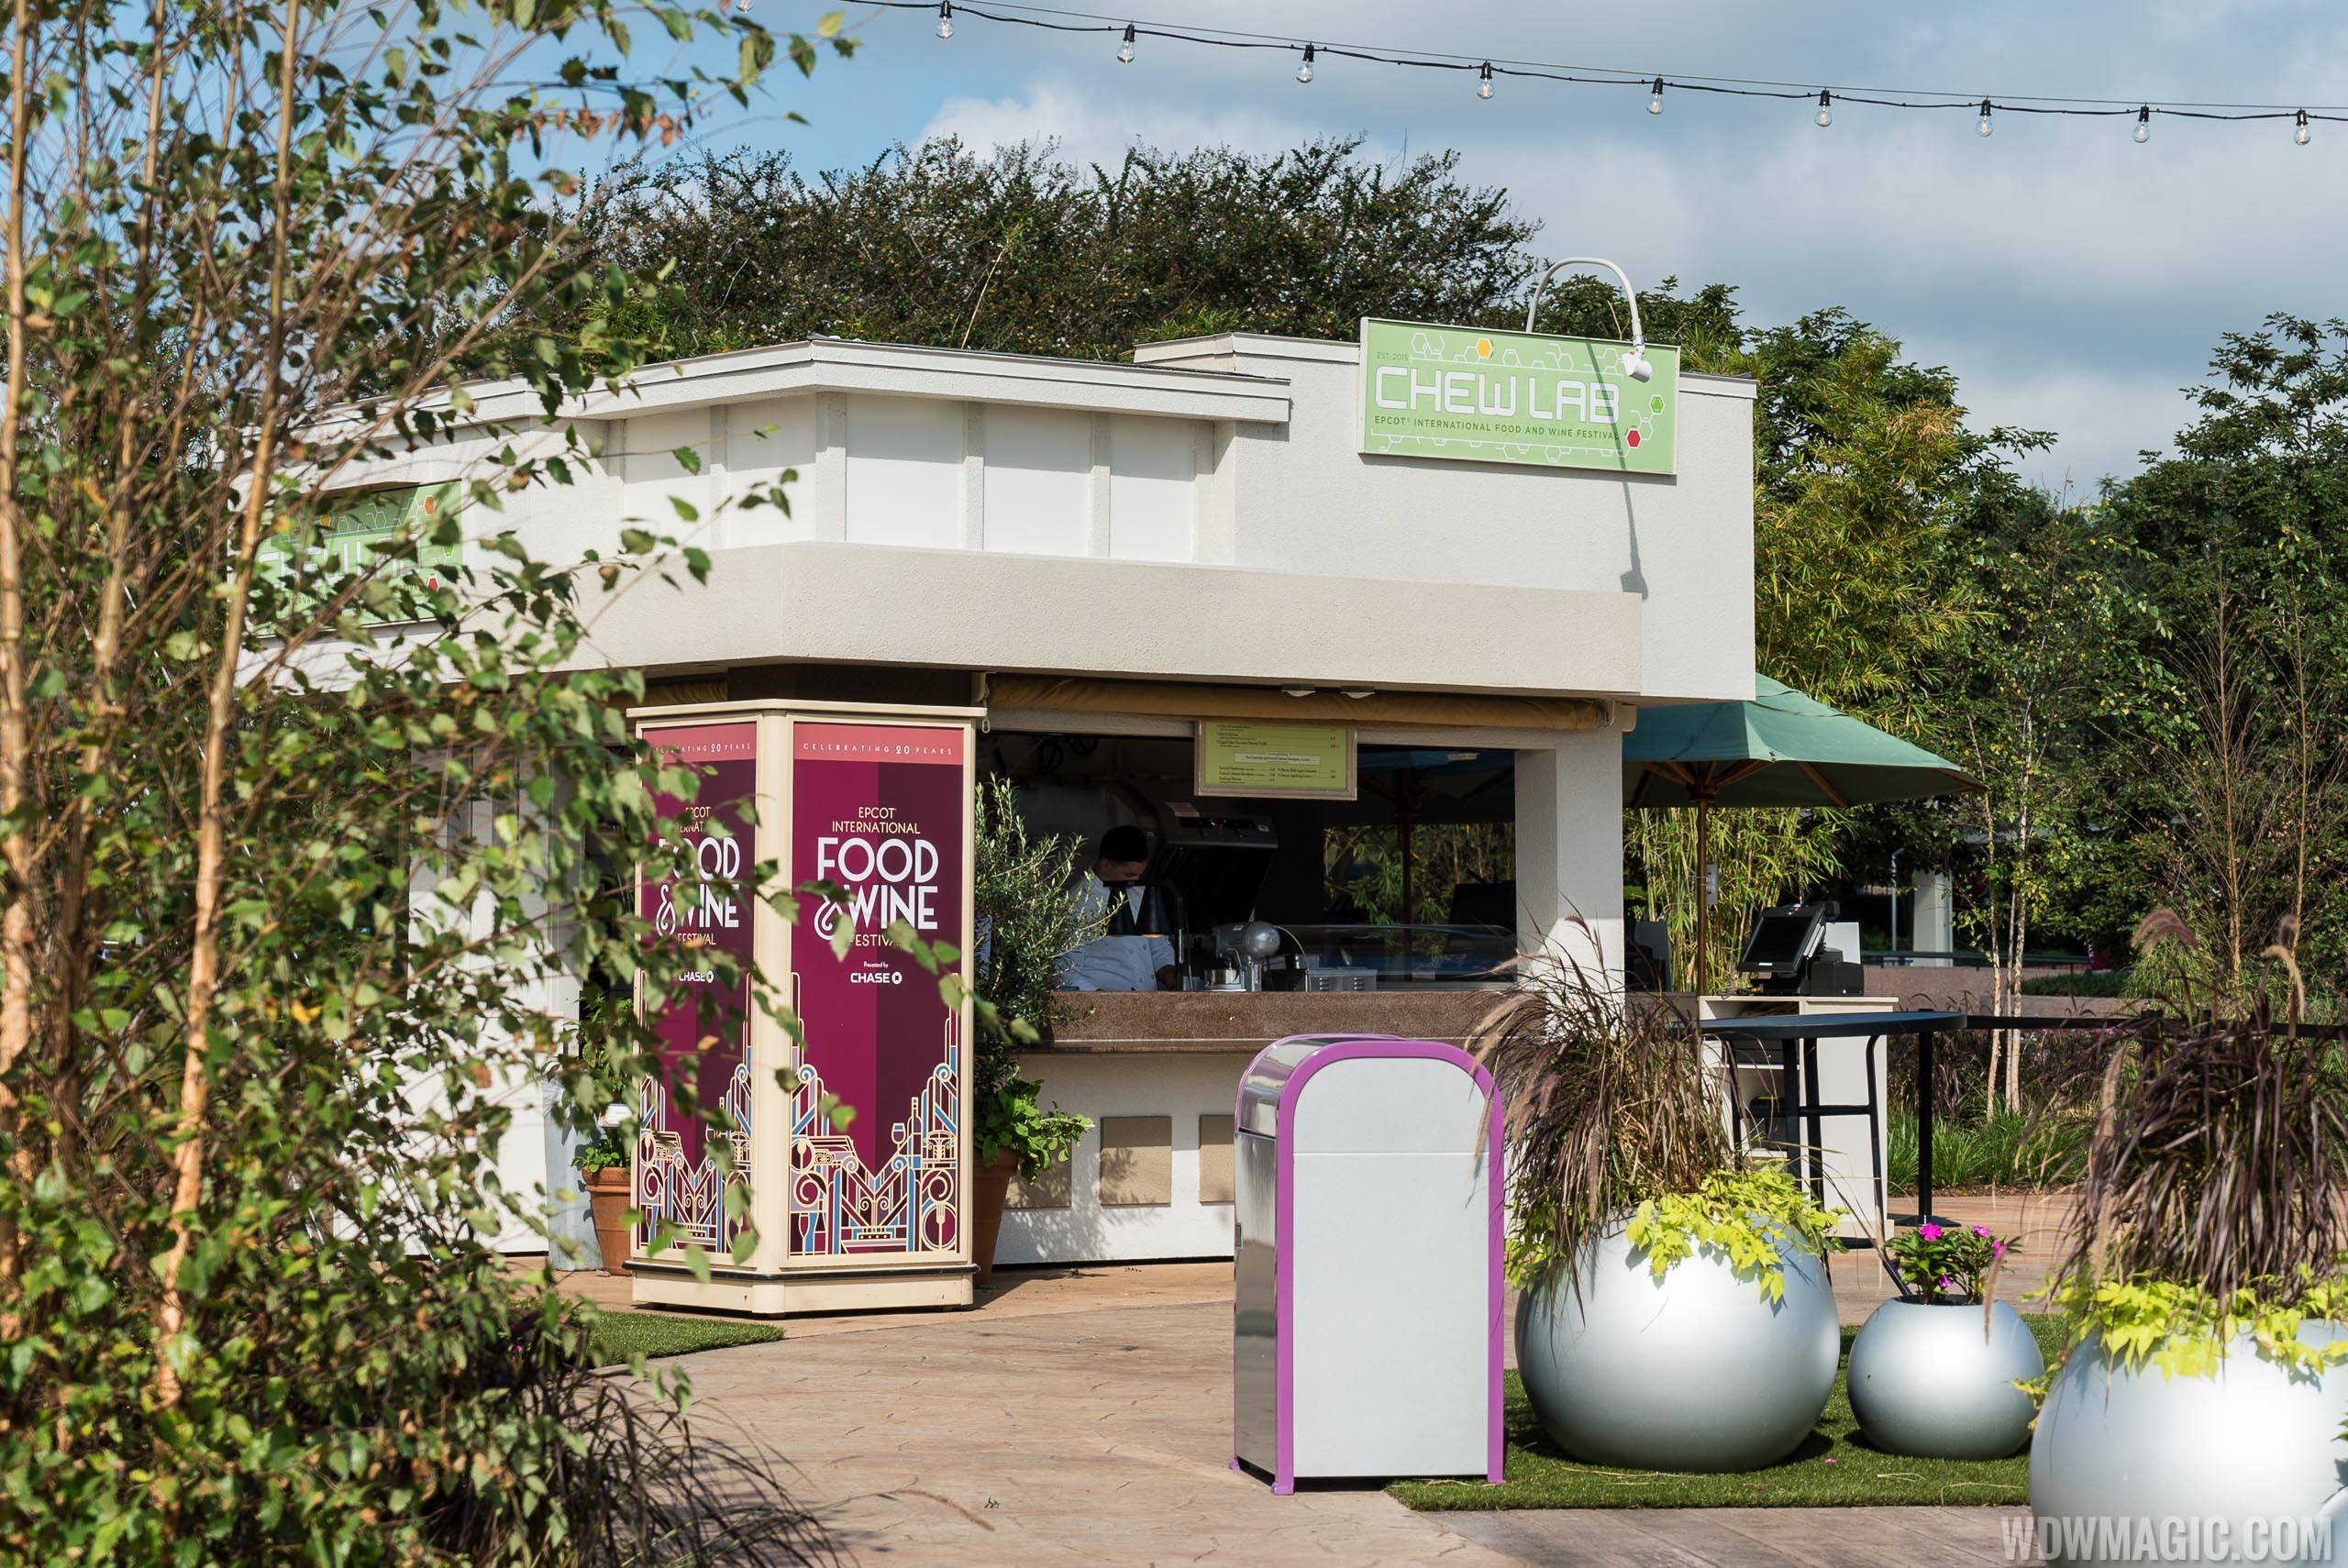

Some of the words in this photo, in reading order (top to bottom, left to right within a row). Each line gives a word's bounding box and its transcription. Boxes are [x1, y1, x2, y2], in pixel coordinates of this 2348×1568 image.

[1376, 366, 1517, 417] CHEW
[1529, 377, 1620, 425] LAB
[1413, 419, 1491, 432] INTERNATIONAL
[1495, 424, 1522, 434] FOOD
[1525, 426, 1545, 436] AND
[1548, 428, 1572, 437] WINE
[1577, 430, 1620, 440] FESTIVAL
[711, 744, 721, 753] 20
[724, 743, 750, 751] YEARS
[803, 743, 890, 753] CELEBRATING
[896, 745, 910, 755] 20
[832, 821, 921, 834] INTERNATIONAL
[817, 837, 939, 883] FOOD
[844, 885, 938, 930] WINE
[849, 933, 902, 947] ESTIV
[850, 972, 891, 984] CHASE
